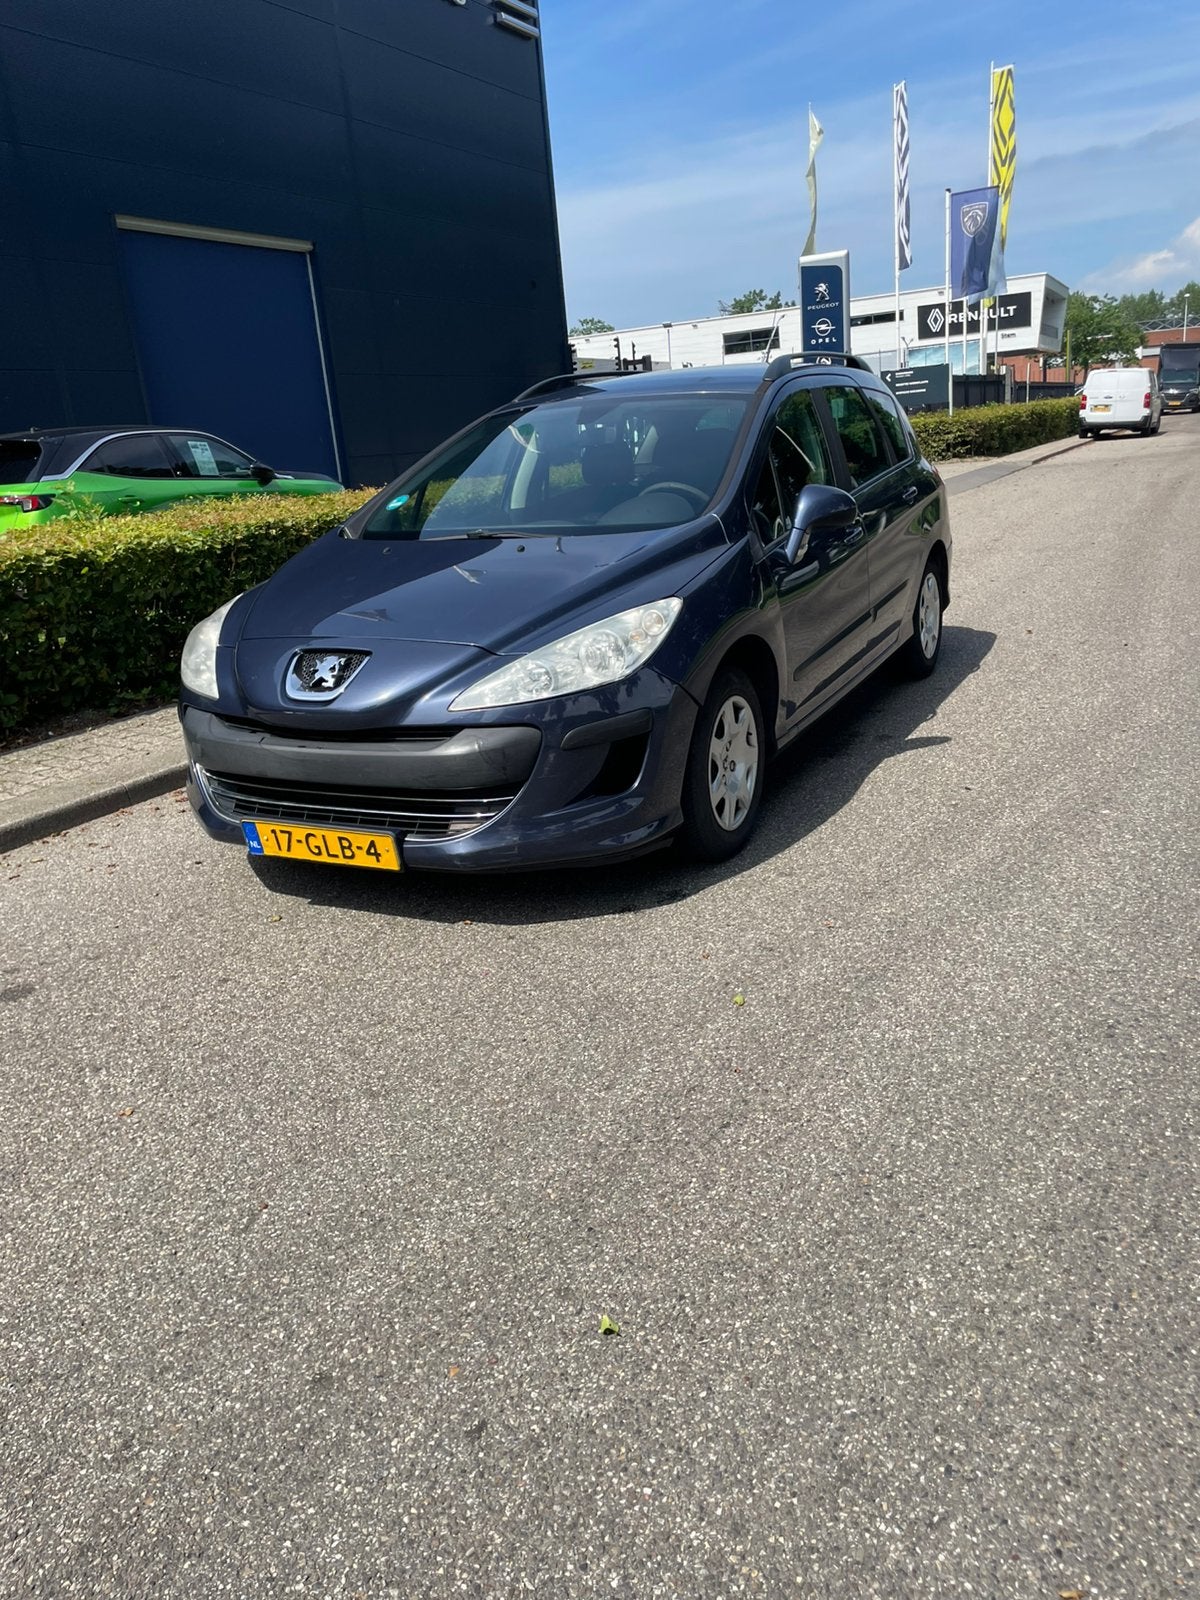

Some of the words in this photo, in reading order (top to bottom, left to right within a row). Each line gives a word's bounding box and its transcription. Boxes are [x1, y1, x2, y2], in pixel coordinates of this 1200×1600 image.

[807, 302, 840, 310] PEUGEOT
[810, 337, 837, 345] OPEL
[249, 840, 262, 849] NL
[271, 829, 382, 863] 17-GLB-4
